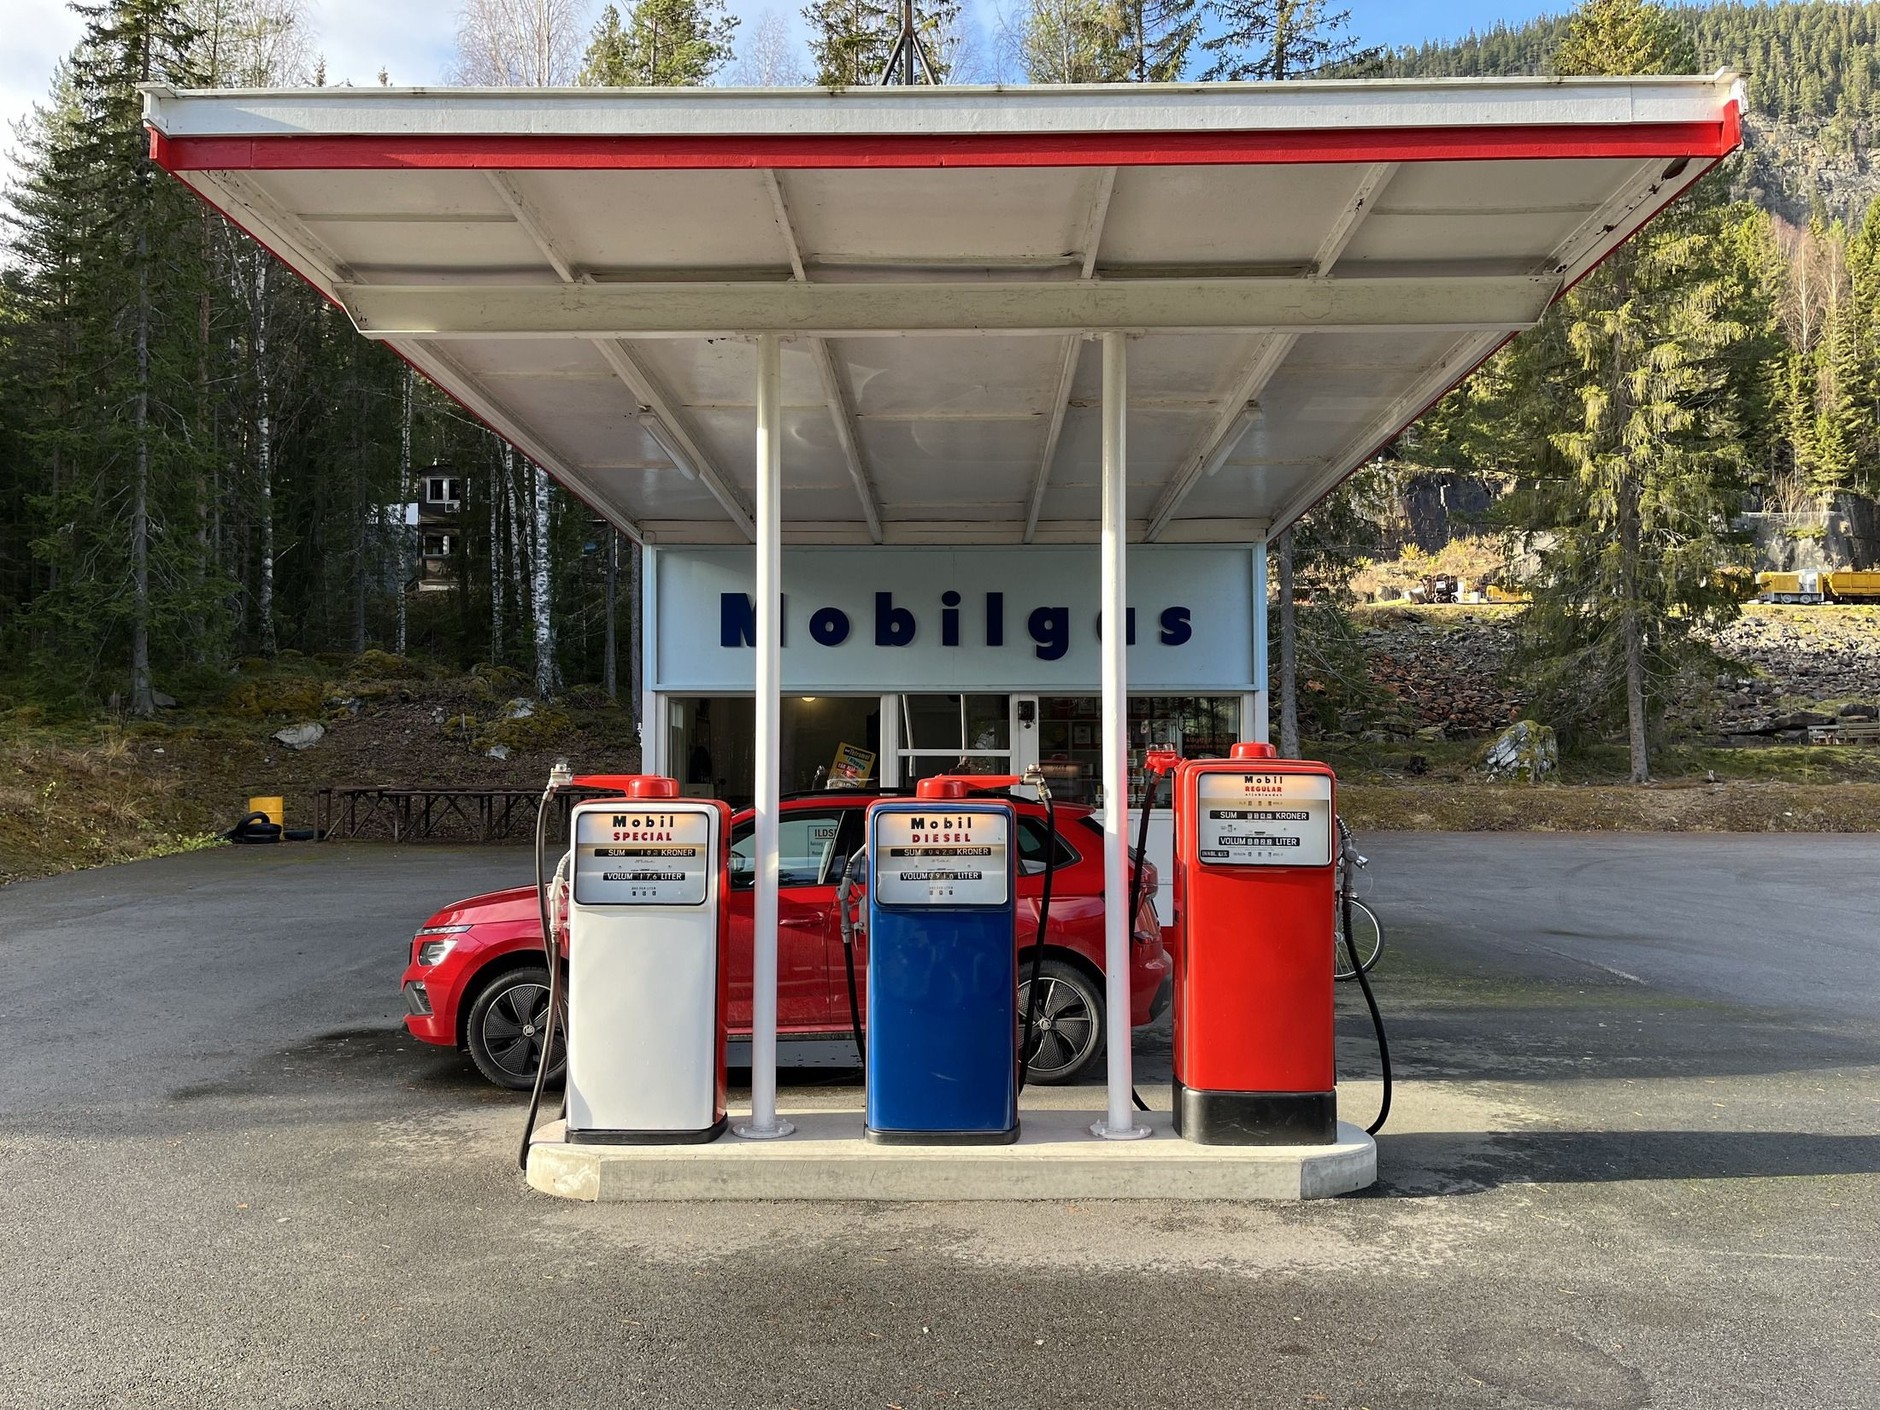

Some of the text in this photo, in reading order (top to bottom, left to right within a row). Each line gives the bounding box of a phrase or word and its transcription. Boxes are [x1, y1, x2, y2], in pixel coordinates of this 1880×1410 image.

[1244, 775, 1283, 784] Mobil
[1244, 785, 1282, 793] REGULAR
[1220, 811, 1237, 819] SUM
[1275, 812, 1307, 820] KRONER
[612, 815, 674, 828] Mobil
[911, 817, 972, 830] Mobil
[613, 832, 672, 841] SPECIAL
[912, 833, 971, 843] DIESEL
[1220, 837, 1246, 845] VOLUM
[1275, 838, 1297, 846] LITER
[904, 849, 921, 857] SUM
[956, 847, 989, 856] KRONER
[607, 872, 633, 880] VOLUM
[661, 872, 682, 880] LITER
[902, 872, 928, 880] VOLUM
[957, 871, 979, 880] LITER
